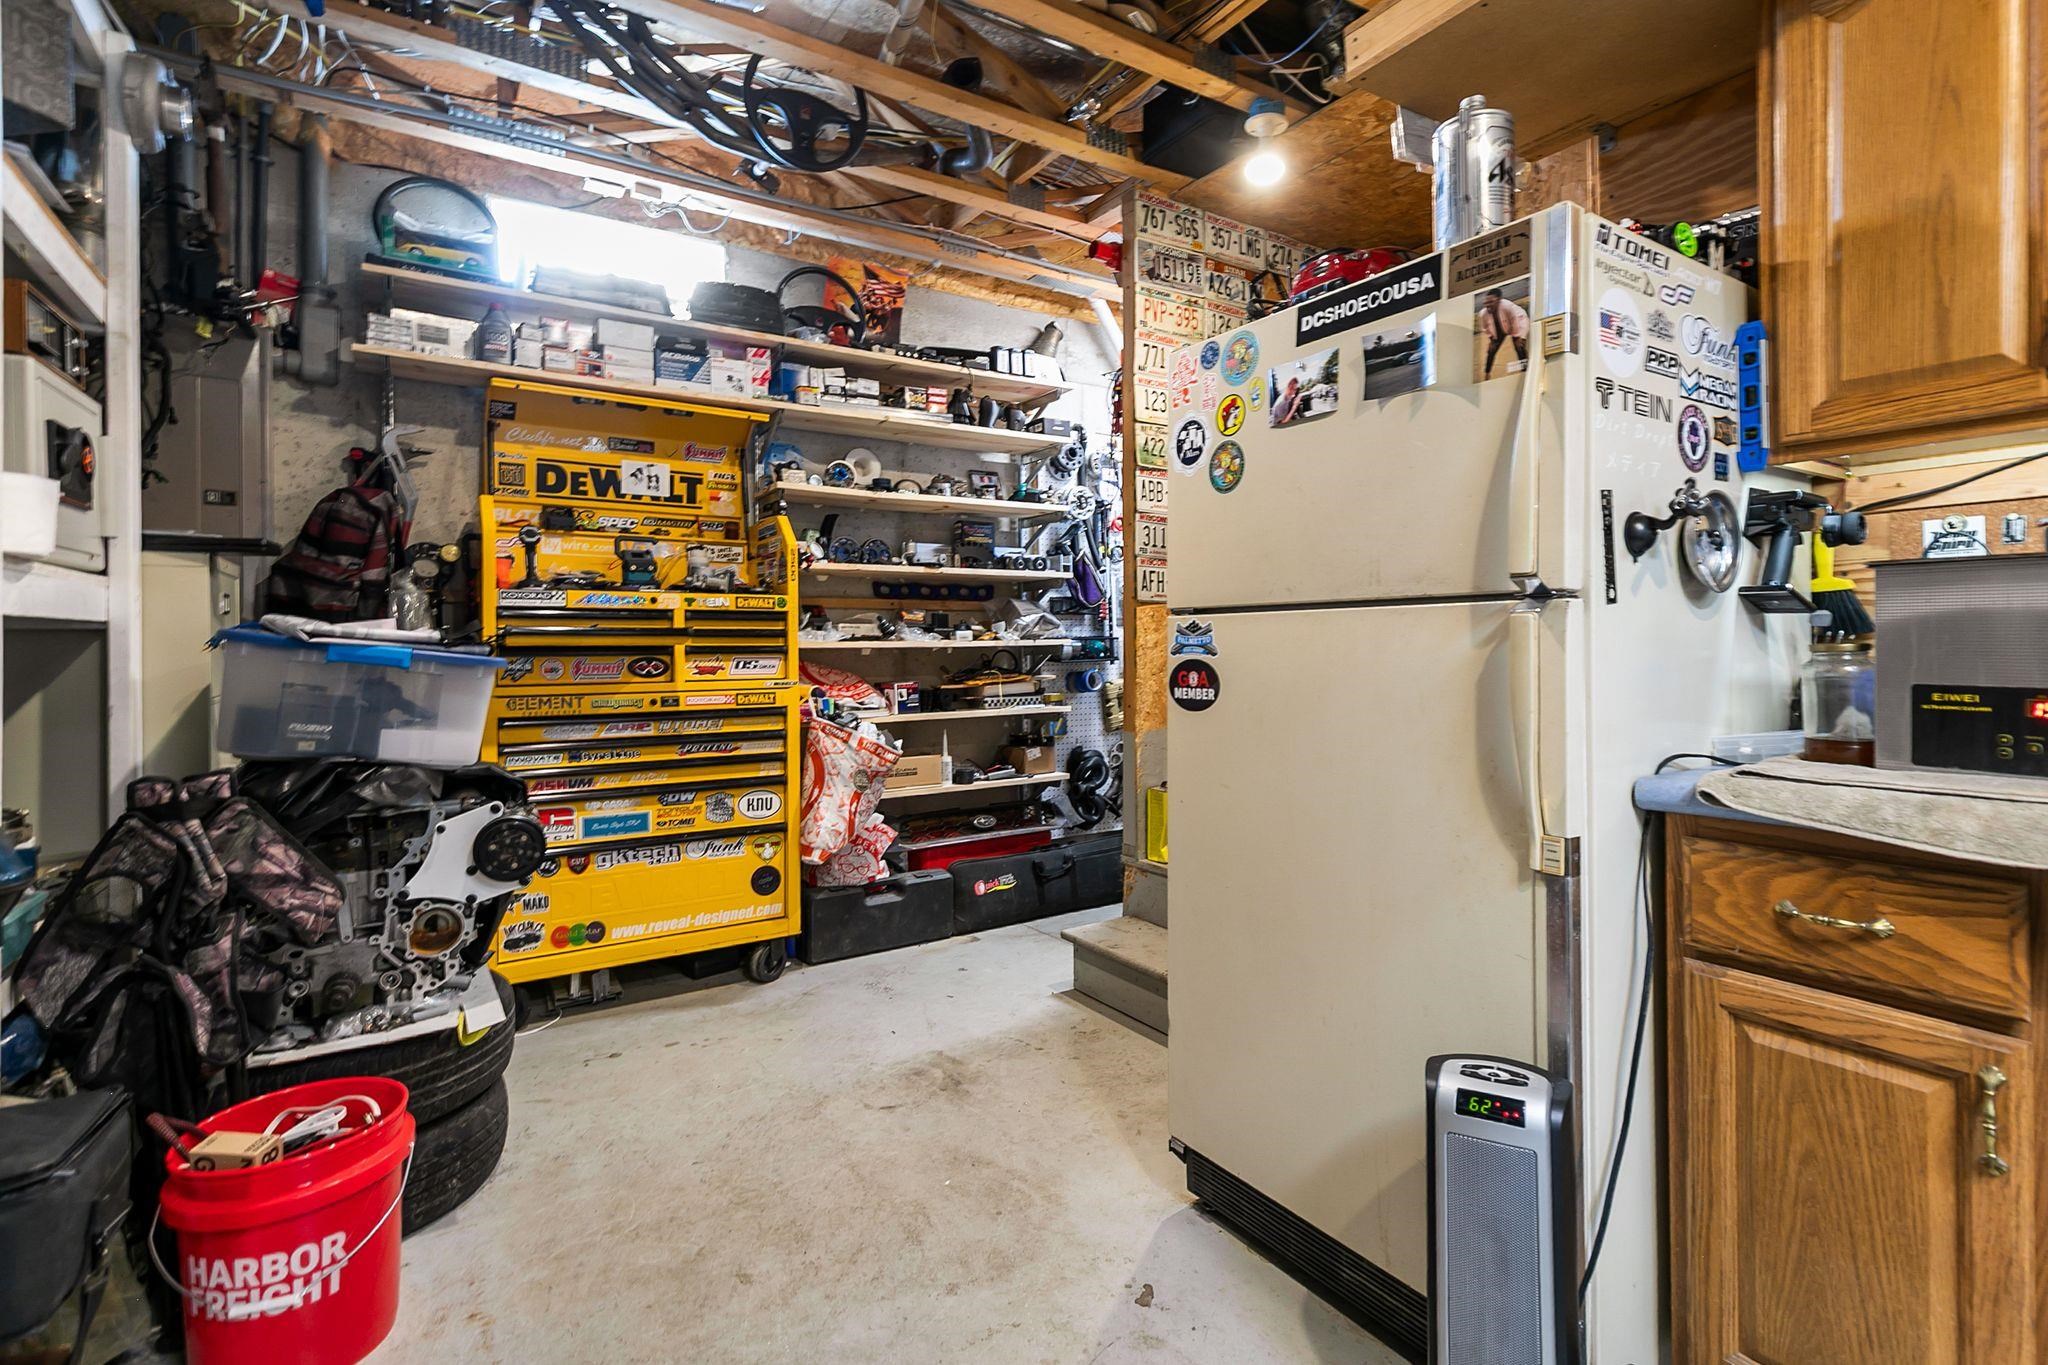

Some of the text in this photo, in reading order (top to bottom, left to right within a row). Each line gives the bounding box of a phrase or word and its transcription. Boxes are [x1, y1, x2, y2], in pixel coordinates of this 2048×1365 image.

[1138, 192, 1180, 210] WISCONSIN
[1142, 203, 1199, 240] 767-SGS
[1466, 234, 1512, 261] OUTLAW
[1614, 232, 1671, 271] TOMEI
[1144, 298, 1199, 330] PVP-395
[1300, 271, 1436, 333] DCSHOECOUSA
[1648, 350, 1679, 370] PRP
[1144, 389, 1167, 413] 123
[1618, 384, 1672, 423] TEIN
[1142, 436, 1166, 458] 422
[536, 462, 704, 504] DEWLT
[598, 516, 639, 528] SPEC
[1143, 525, 1167, 549] 311
[501, 591, 550, 600] KOYORAD
[737, 694, 775, 704] DEWALT
[1174, 687, 1216, 701] MEMBER
[611, 902, 783, 939] www.reveal-designed.com
[1468, 1096, 1492, 1115] 62
[187, 1231, 349, 1291] HARBOR
[189, 1263, 349, 1322] FREIGHT
